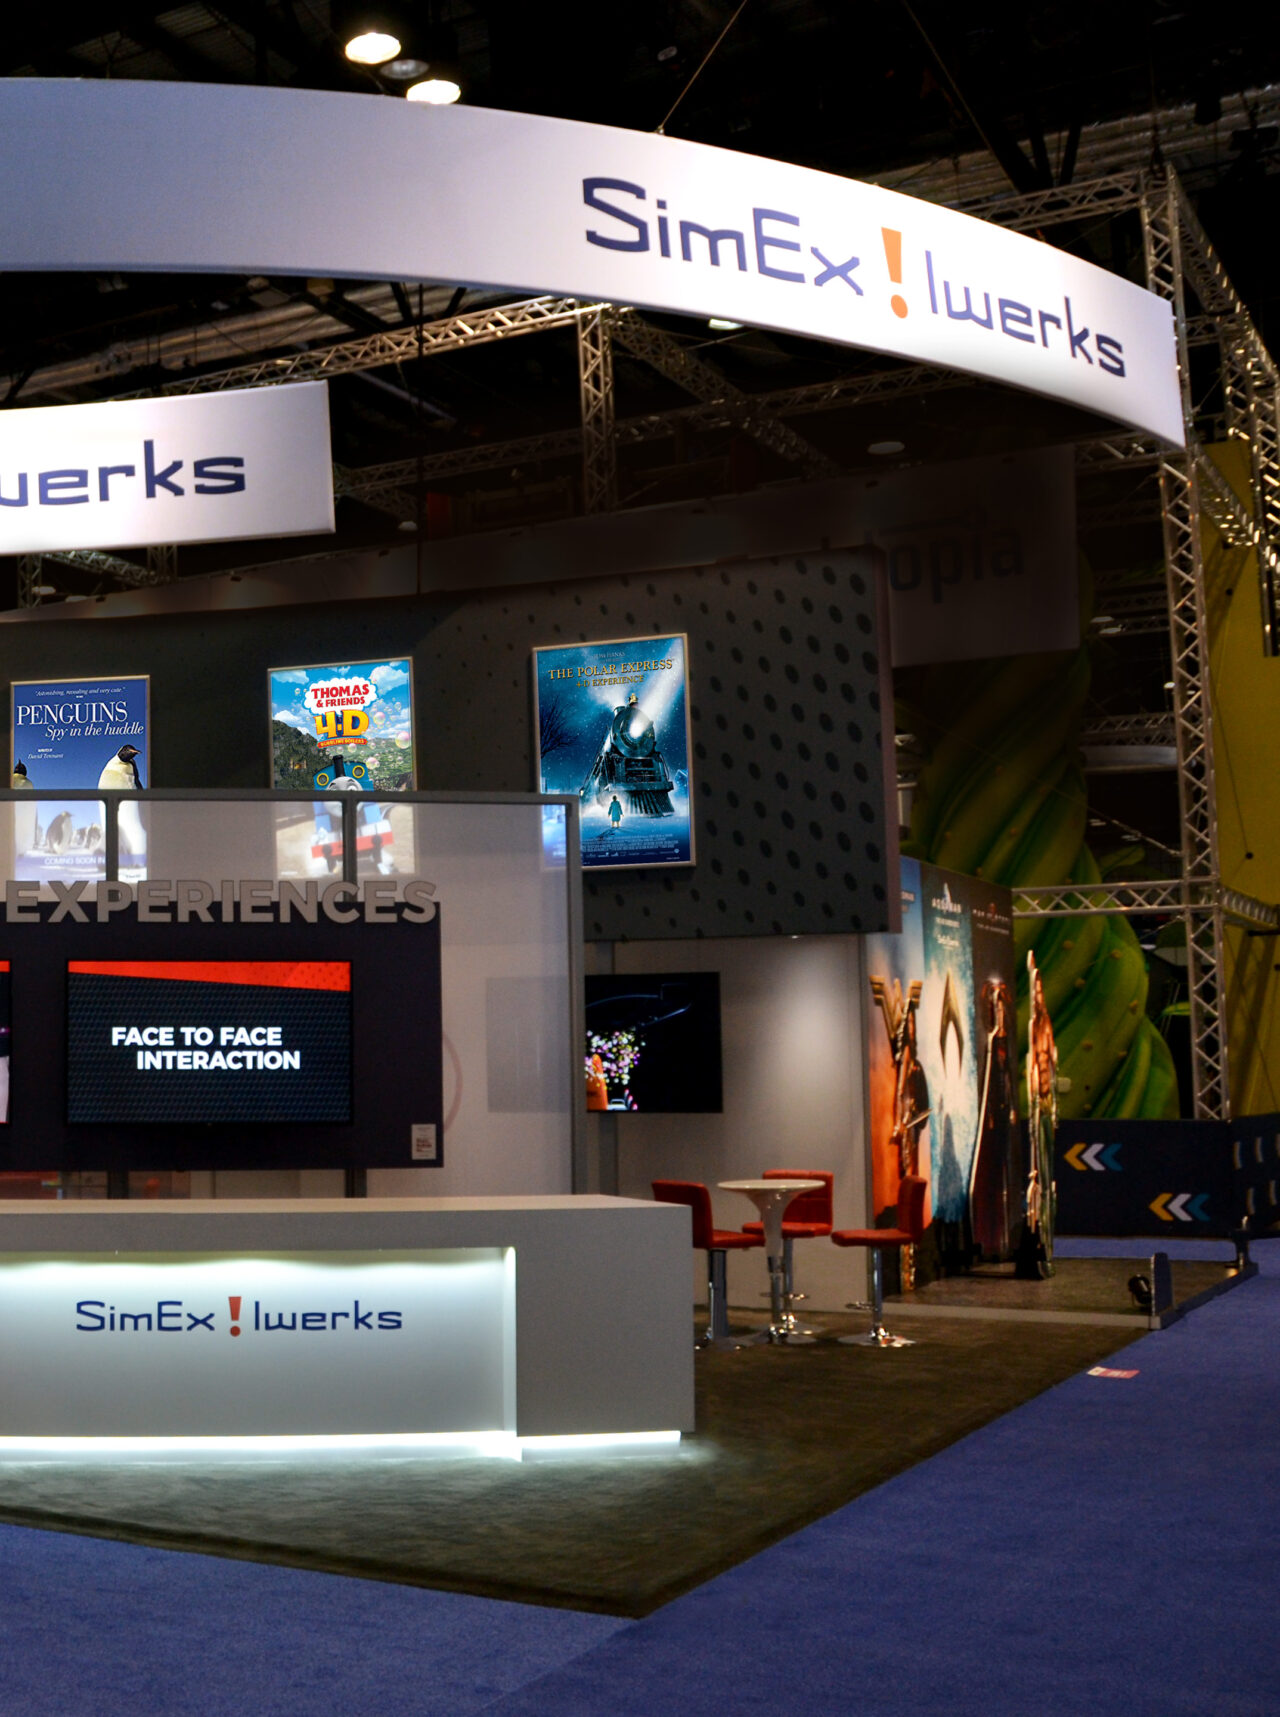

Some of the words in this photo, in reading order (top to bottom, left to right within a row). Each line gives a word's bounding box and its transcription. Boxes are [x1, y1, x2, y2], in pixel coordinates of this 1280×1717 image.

[581, 177, 864, 296] SimEx
[548, 668, 574, 680] THE
[577, 664, 618, 677] POLAR
[621, 658, 673, 674] EXPRESS
[592, 674, 644, 687] EXPERIENCE
[311, 683, 370, 699] THOMAS
[316, 699, 323, 708] &
[325, 696, 366, 707] FRIENDS
[16, 700, 128, 725] PENGUINS
[45, 724, 68, 741] Spy
[70, 723, 81, 736] in
[84, 723, 102, 736] the
[104, 721, 144, 735] huddle
[6, 880, 438, 924] EXPERIENCES
[111, 1027, 174, 1047] FACE
[180, 1027, 215, 1047] TO
[220, 1027, 282, 1047] FACE
[137, 1051, 301, 1070] INTERACTION
[75, 1300, 216, 1332] SimEx
